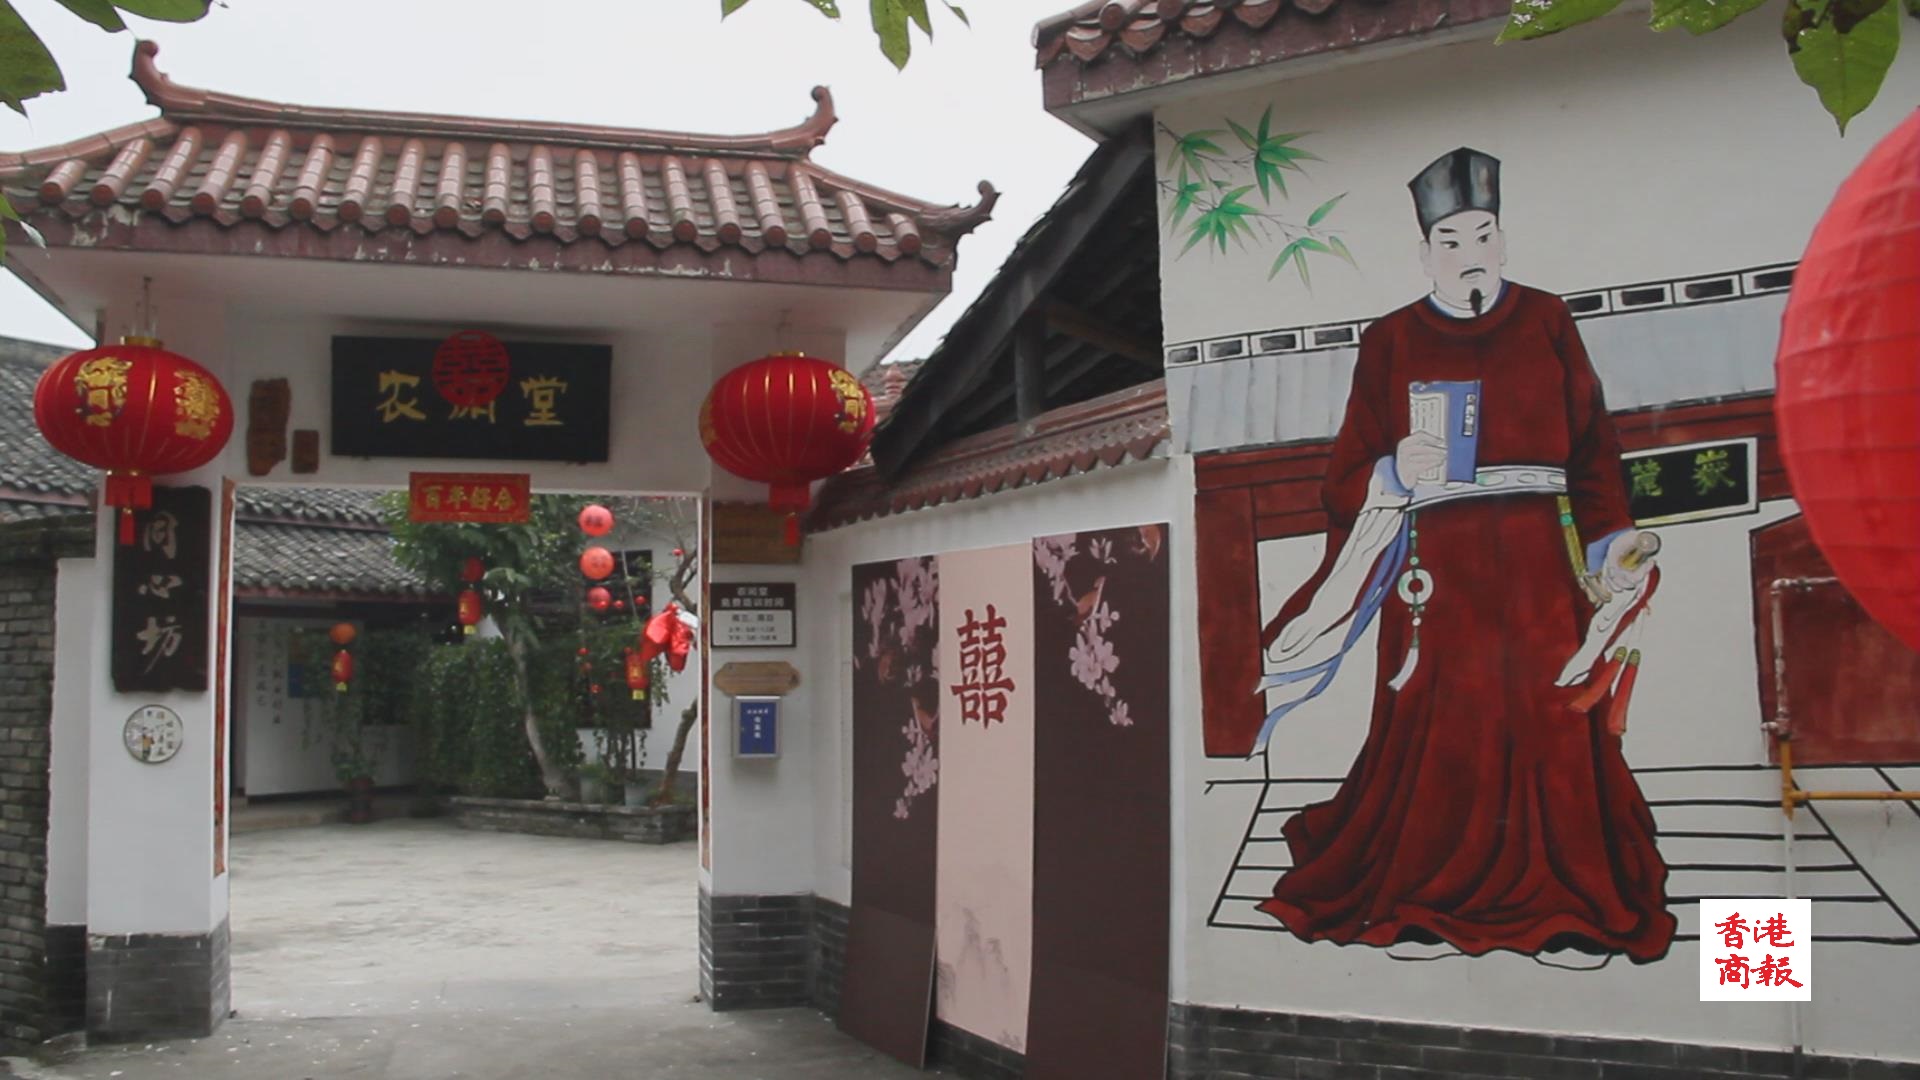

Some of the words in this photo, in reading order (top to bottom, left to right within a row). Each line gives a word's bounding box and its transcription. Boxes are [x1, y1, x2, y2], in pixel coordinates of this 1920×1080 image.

[422, 484, 516, 511] 百年好合
[137, 510, 184, 676] 同心坊
